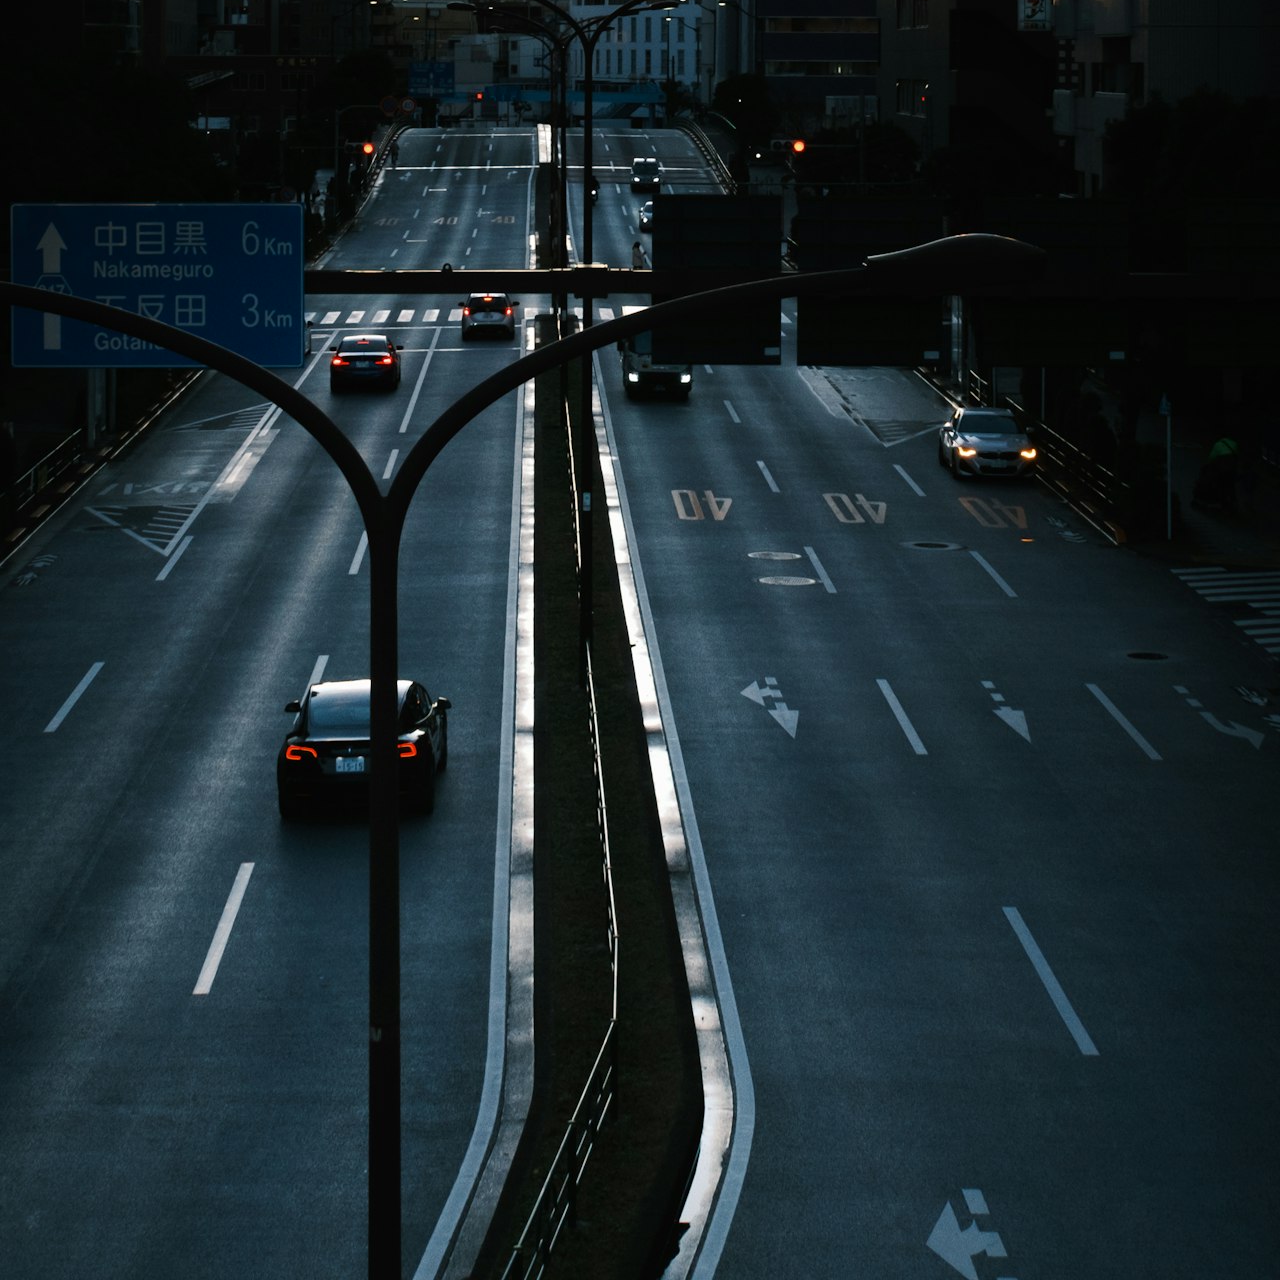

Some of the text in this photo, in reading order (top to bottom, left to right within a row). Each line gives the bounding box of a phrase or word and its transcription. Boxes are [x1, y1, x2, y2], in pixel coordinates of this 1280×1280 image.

[432, 216, 459, 226] 40
[491, 215, 516, 225] 40
[94, 221, 208, 256] 中目黒
[93, 261, 215, 282] Nakameguro
[94, 332, 167, 352] Gotan
[671, 489, 733, 522] 40
[822, 493, 888, 525] 40
[958, 496, 1030, 529] 40
